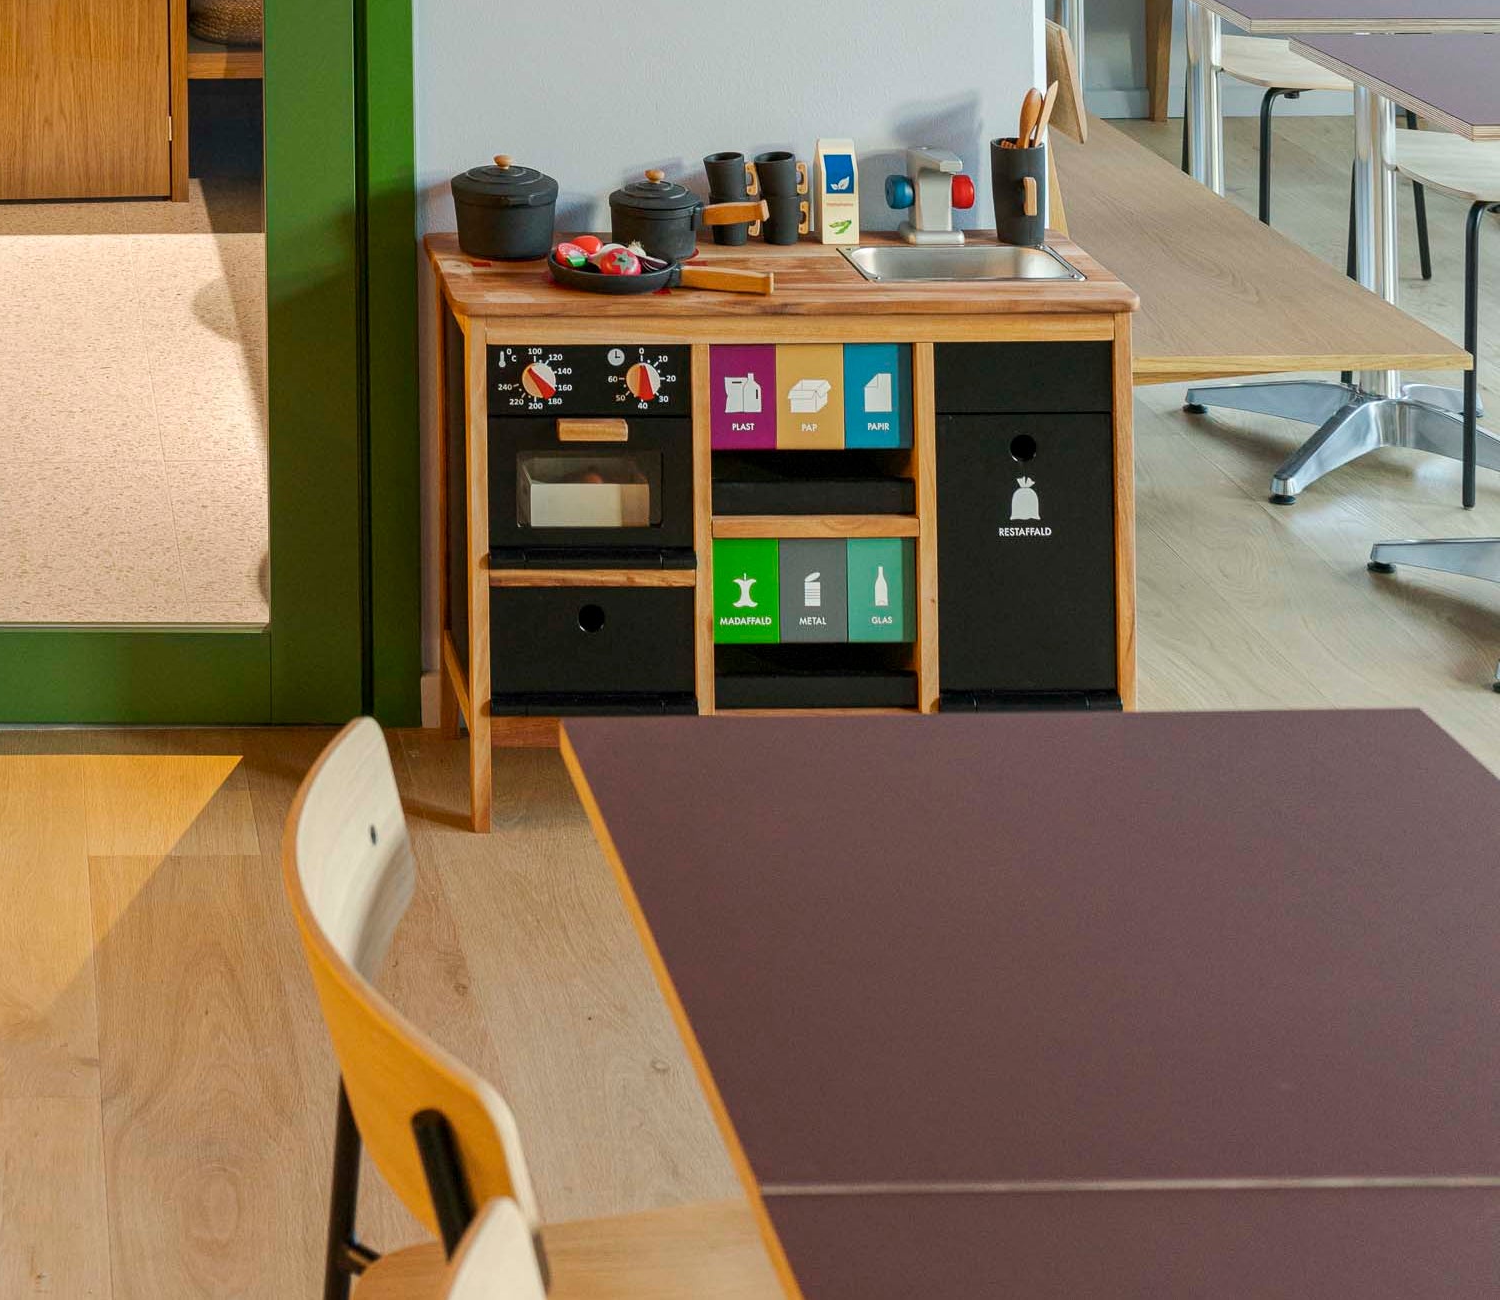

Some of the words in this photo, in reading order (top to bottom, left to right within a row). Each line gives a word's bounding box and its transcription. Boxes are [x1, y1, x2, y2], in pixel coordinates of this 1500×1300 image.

[658, 355, 668, 363] 10
[608, 375, 618, 383] 60
[509, 398, 524, 406] 220
[615, 394, 626, 402] 50
[658, 395, 669, 403] 30
[528, 402, 543, 410] 200
[637, 402, 648, 410] 40
[731, 422, 755, 431] PLAST
[801, 424, 818, 432] PAP
[867, 422, 890, 431] PAPIR
[998, 527, 1052, 537] RESTAFFALD
[719, 616, 772, 626] MADAFFALD
[799, 616, 827, 625] METAL
[871, 616, 893, 624] GLAS
